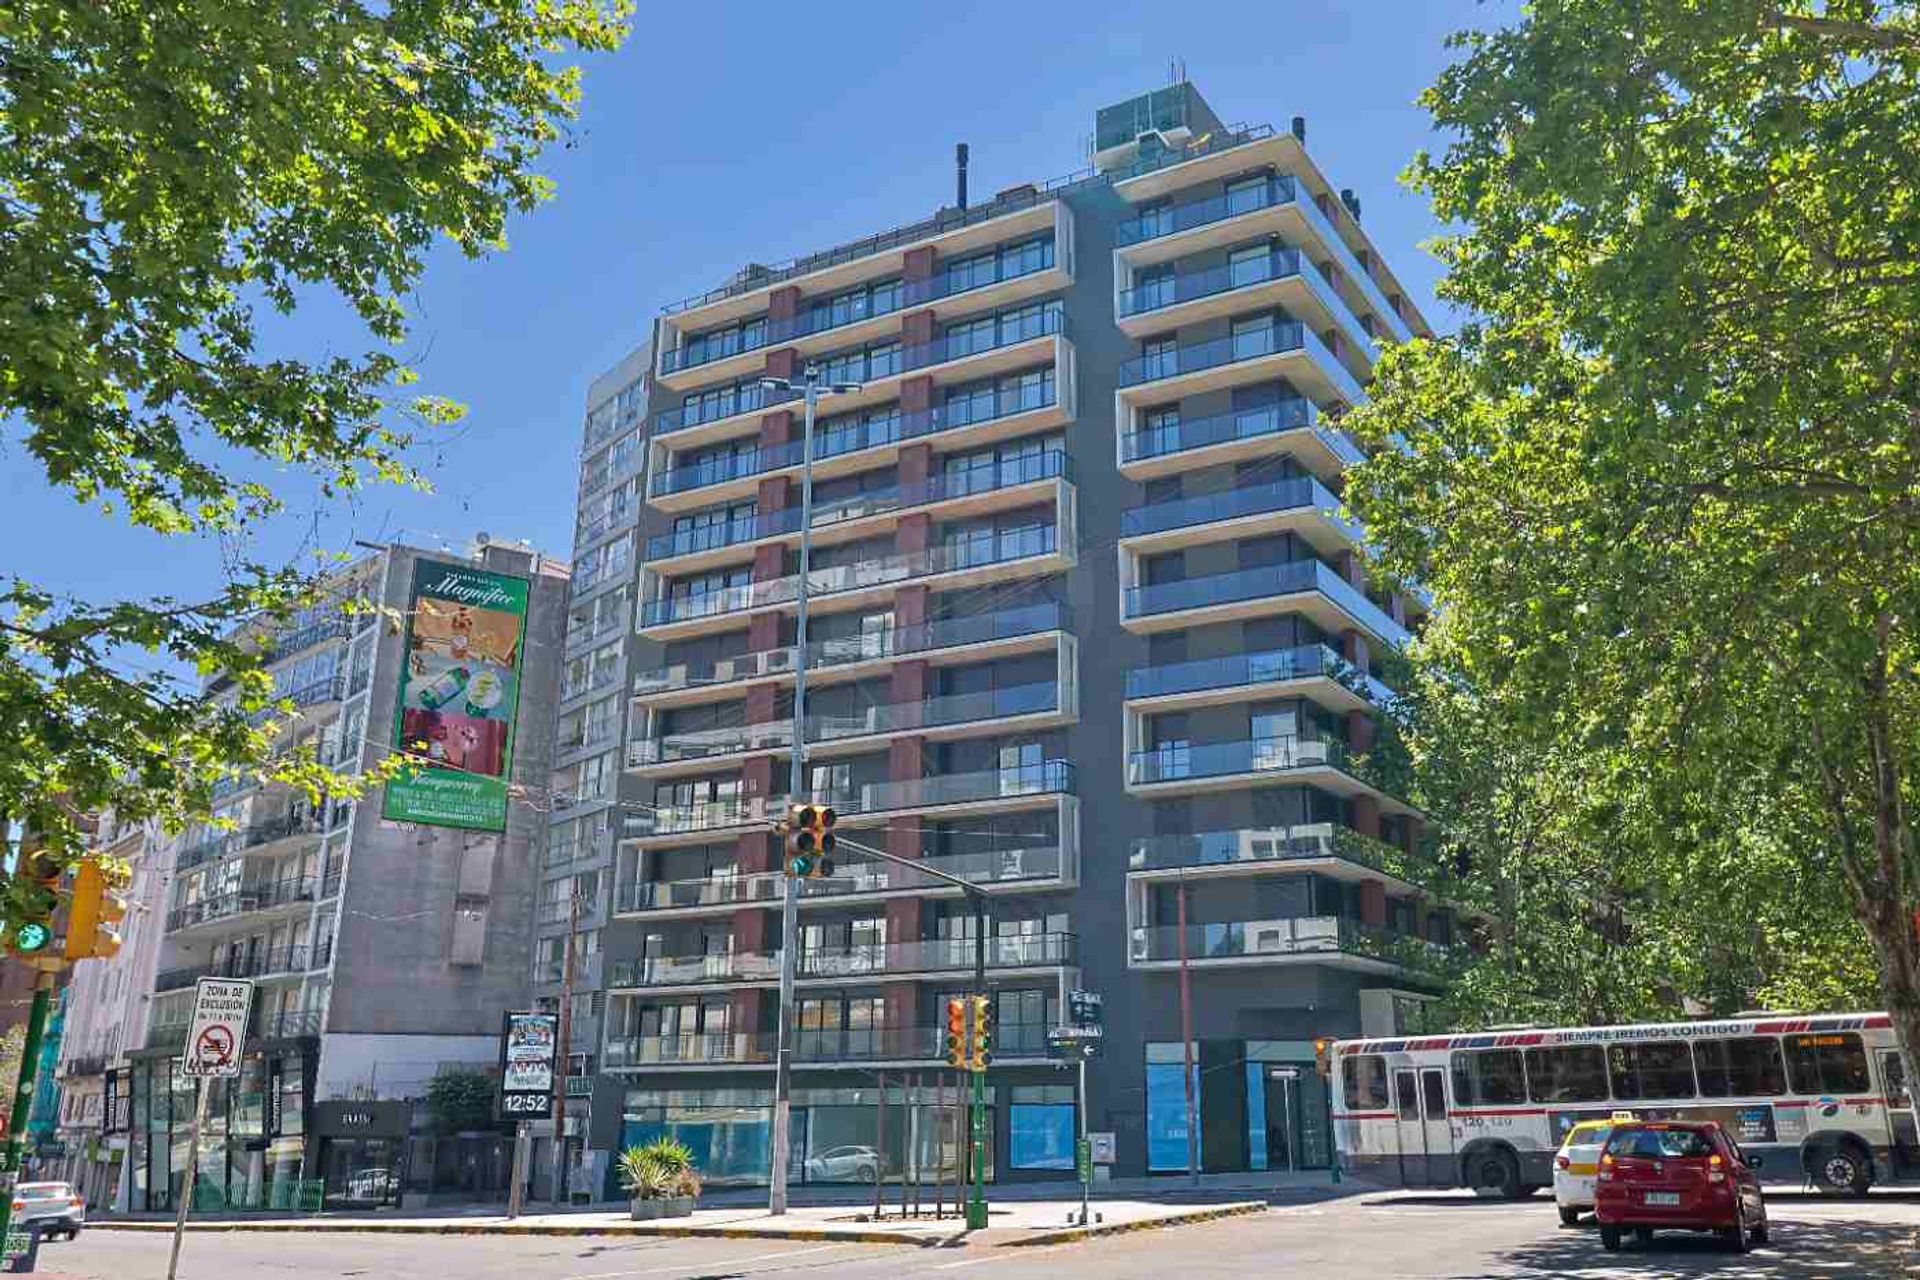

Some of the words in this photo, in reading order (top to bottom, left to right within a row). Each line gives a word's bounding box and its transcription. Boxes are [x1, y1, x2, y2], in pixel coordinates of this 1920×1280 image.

[206, 985, 228, 997] ZONA
[232, 987, 244, 997] DE
[1556, 1029, 1613, 1042] SIEMPRE
[1615, 1027, 1667, 1039] IREMOS
[1672, 1023, 1740, 1036] CONTIGO
[504, 1094, 548, 1112] 12:52
